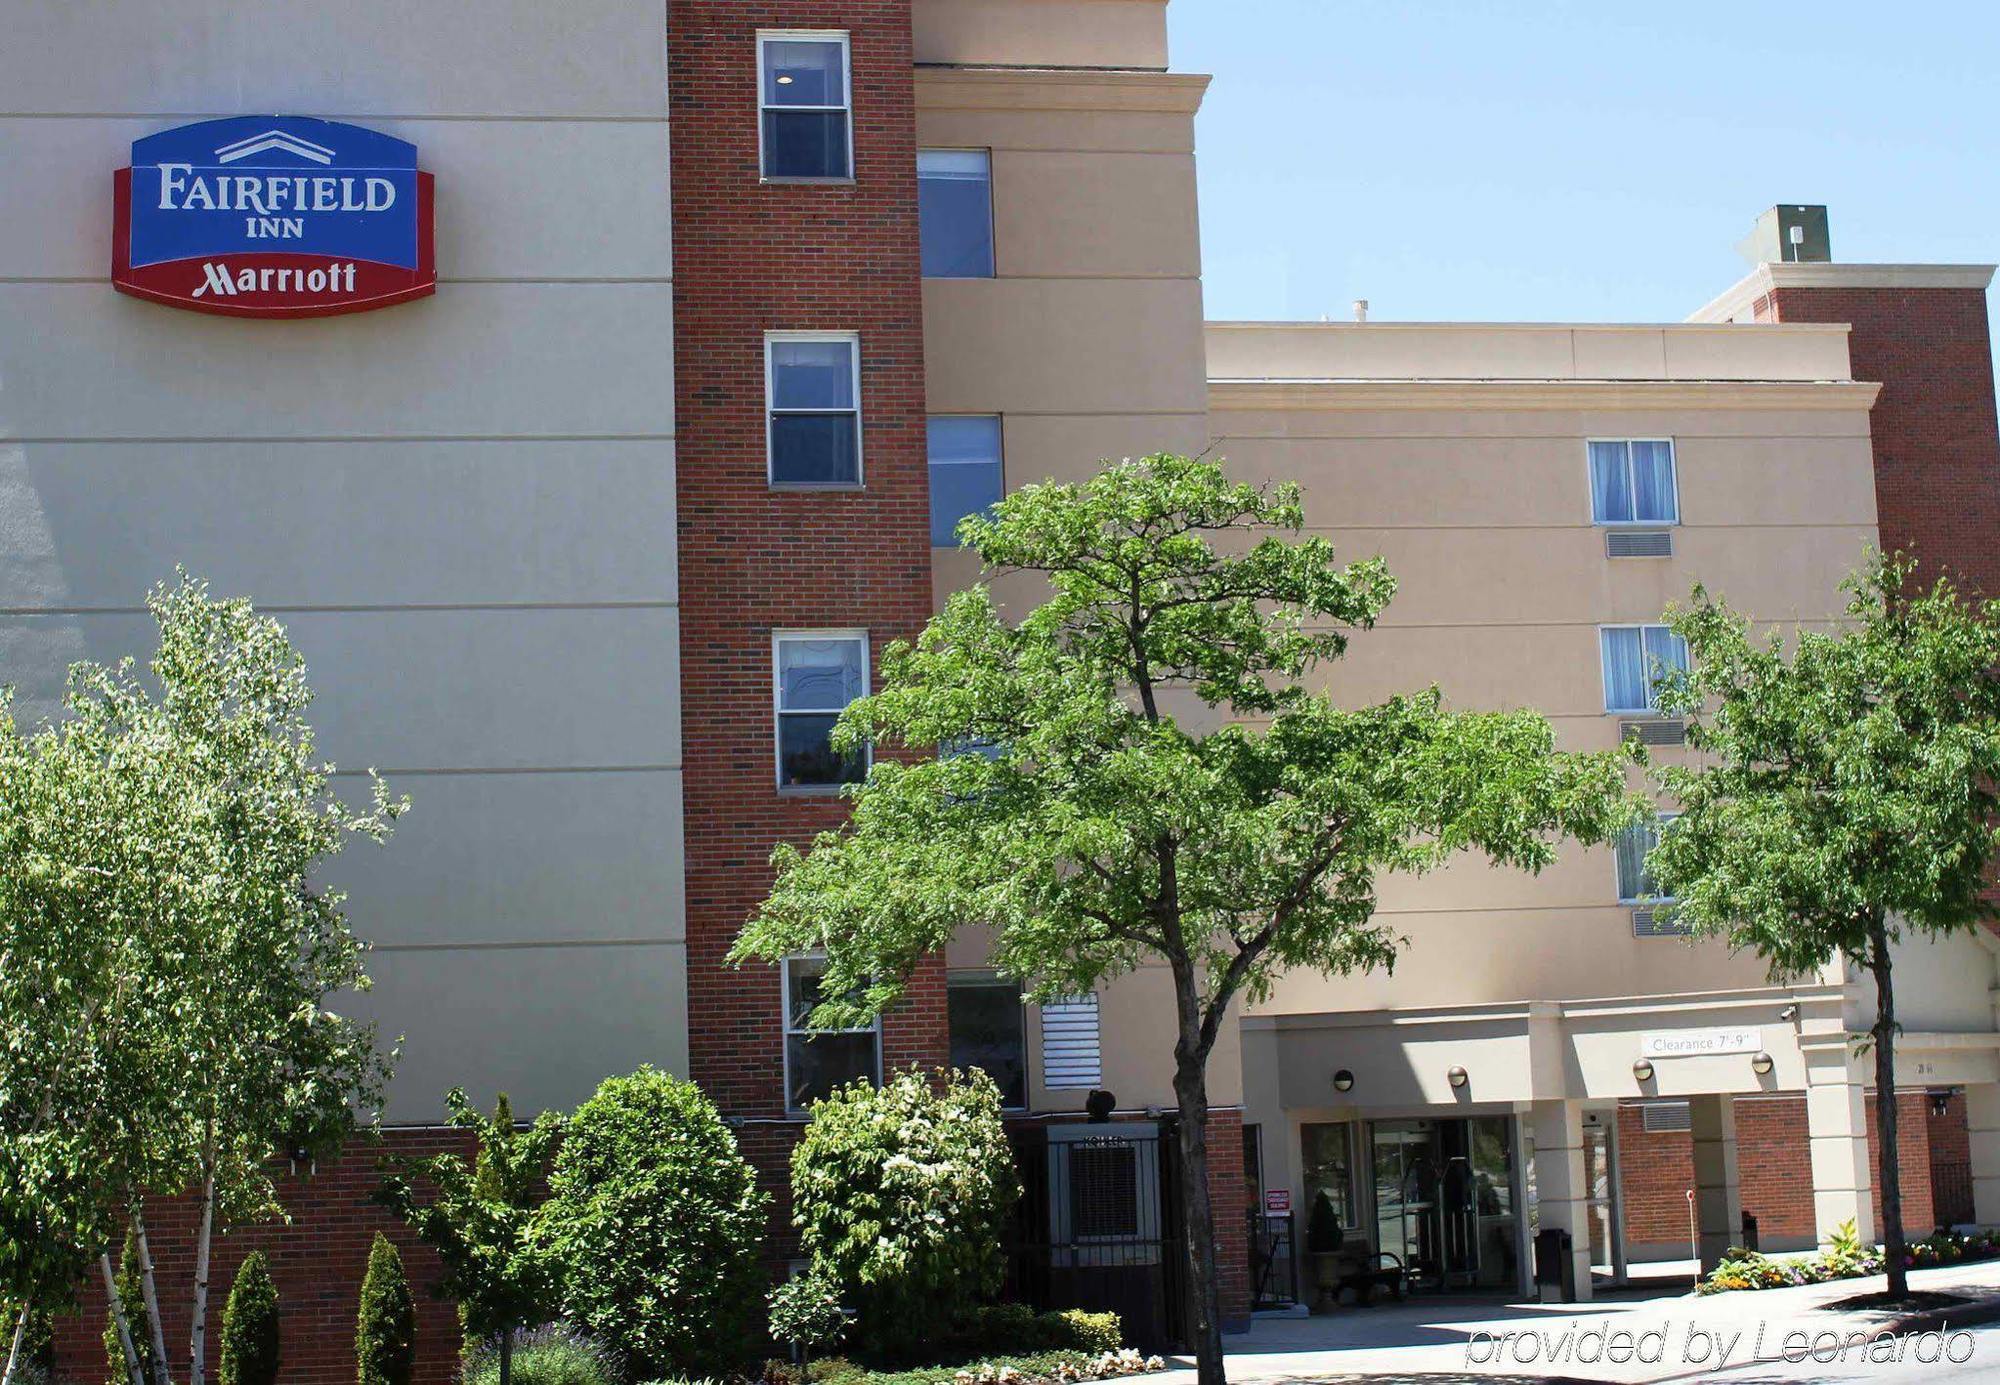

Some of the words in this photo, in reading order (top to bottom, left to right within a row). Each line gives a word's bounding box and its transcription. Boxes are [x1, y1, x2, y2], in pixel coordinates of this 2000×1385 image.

[157, 163, 396, 214] FAIRFIELD
[246, 218, 304, 238] INN
[192, 262, 357, 297] Marriott
[1653, 1039, 1713, 1051] Clearance
